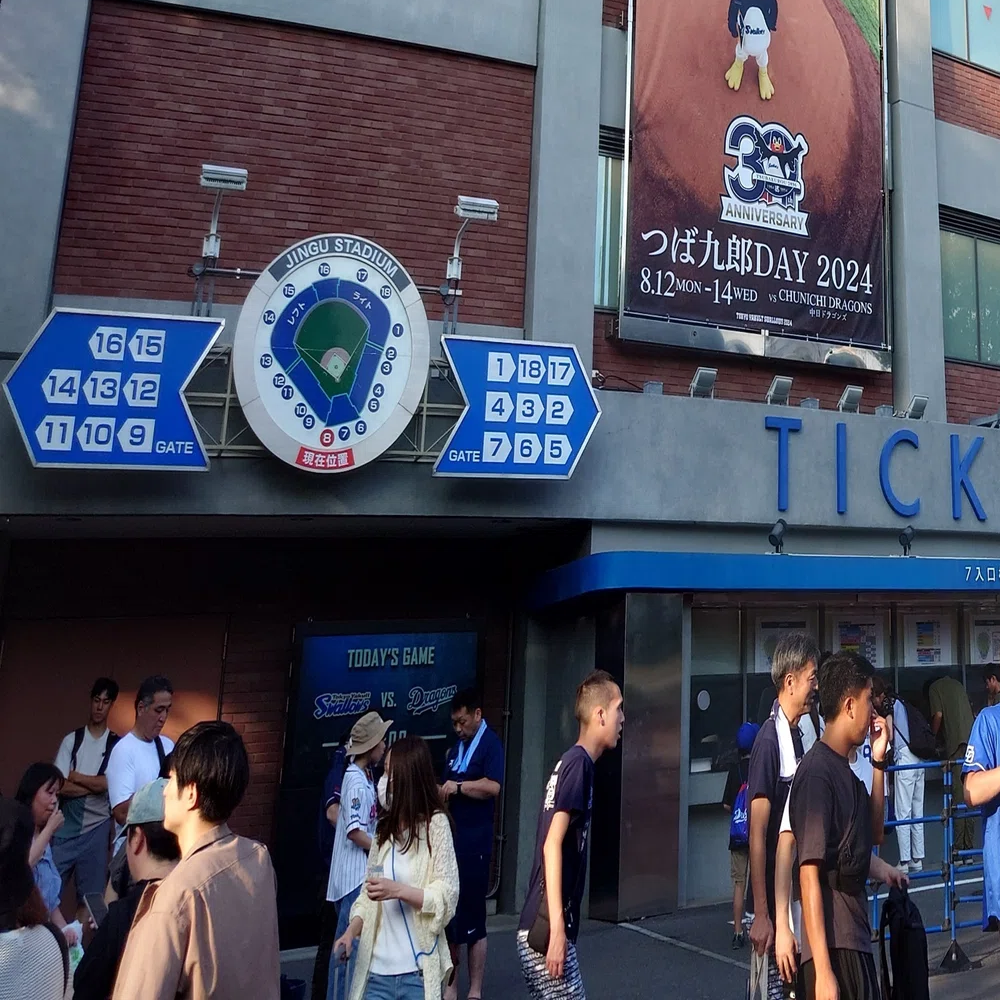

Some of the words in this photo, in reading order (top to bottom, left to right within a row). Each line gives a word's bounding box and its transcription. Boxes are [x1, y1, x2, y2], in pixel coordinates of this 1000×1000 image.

[725, 203, 804, 230] ANNIVERSARY
[286, 238, 329, 269] JINGU
[334, 238, 398, 278] STADIUM
[320, 266, 330, 274] 16
[357, 272, 367, 280] 17
[817, 254, 873, 295] 2024
[284, 286, 294, 295] 15
[352, 290, 372, 310] ライト
[380, 288, 391, 296] 18
[287, 301, 306, 325] レフト
[778, 289, 828, 308] CHUNICHI
[828, 296, 873, 315] DRAGONS
[264, 313, 275, 322] 14
[95, 331, 124, 354] 16
[136, 333, 162, 356] 15
[261, 356, 272, 365] 13
[496, 358, 503, 376] 1
[520, 359, 541, 379] 18
[550, 361, 571, 380] 17
[48, 375, 77, 398] 14
[90, 377, 118, 399] 13
[130, 379, 158, 401] 12
[274, 377, 286, 386] 12
[283, 388, 293, 397] 11
[295, 406, 306, 414] 10
[491, 397, 505, 416] 4
[521, 399, 535, 418] 3
[551, 401, 564, 419] 2
[45, 422, 67, 444] 11
[84, 423, 112, 445] 10
[129, 424, 146, 446] 9
[156, 441, 193, 454] GATE
[303, 450, 349, 467] 現在位置
[449, 450, 480, 462] GATE
[489, 438, 503, 456] 7
[520, 439, 532, 458] 6
[550, 440, 562, 458] 5
[348, 648, 399, 668] TODAY'S
[402, 646, 435, 665] GAME
[313, 693, 370, 719] Swallows
[381, 692, 397, 708] VS.
